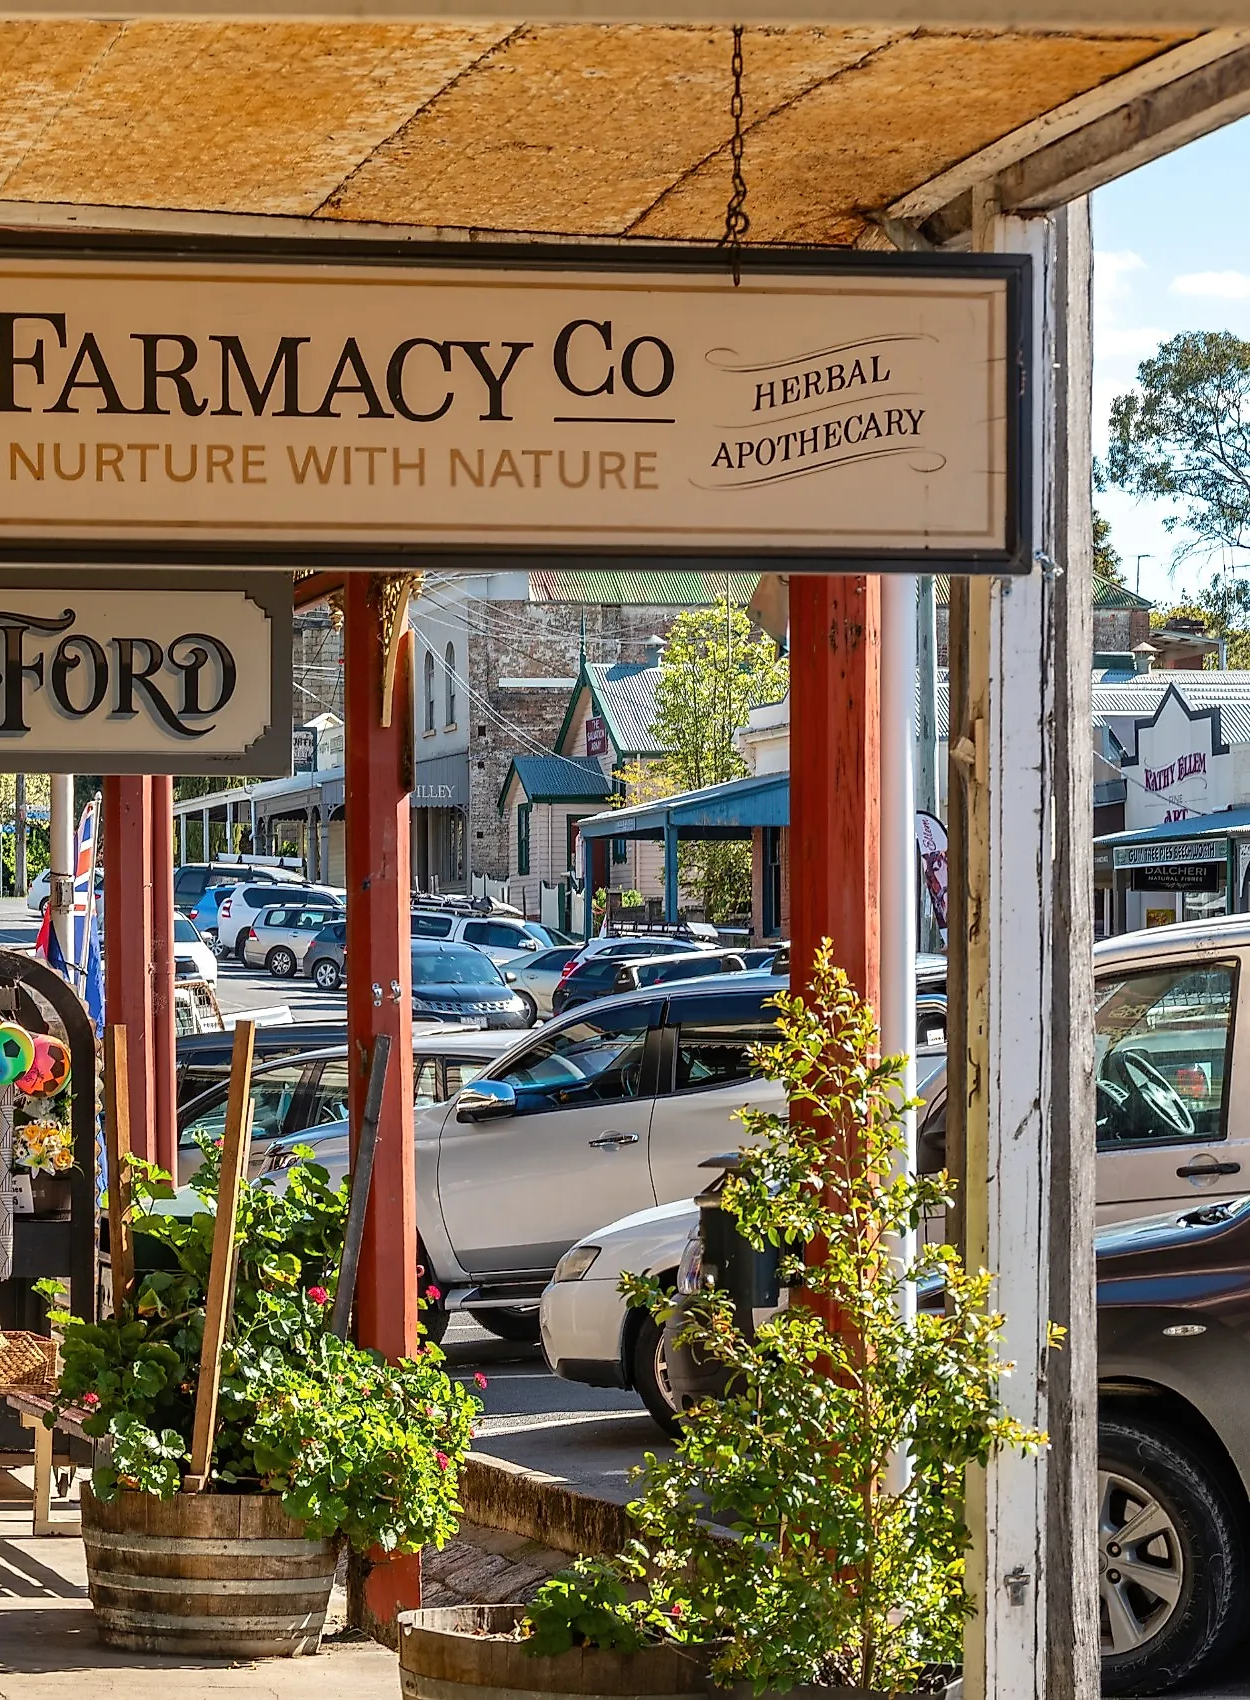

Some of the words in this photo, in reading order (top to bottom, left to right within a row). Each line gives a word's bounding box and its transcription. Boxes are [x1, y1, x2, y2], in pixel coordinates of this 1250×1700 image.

[753, 355, 892, 412] HERBAL
[711, 408, 927, 470] APOTHECARY
[10, 442, 269, 483] NURTURE
[287, 444, 426, 487] WITH
[448, 448, 661, 491] NATURE
[415, 785, 456, 798] ILLEY
[1144, 763, 1176, 792] KATHY
[1177, 752, 1207, 781] ELLEM
[1144, 866, 1207, 876] DALCHERI
